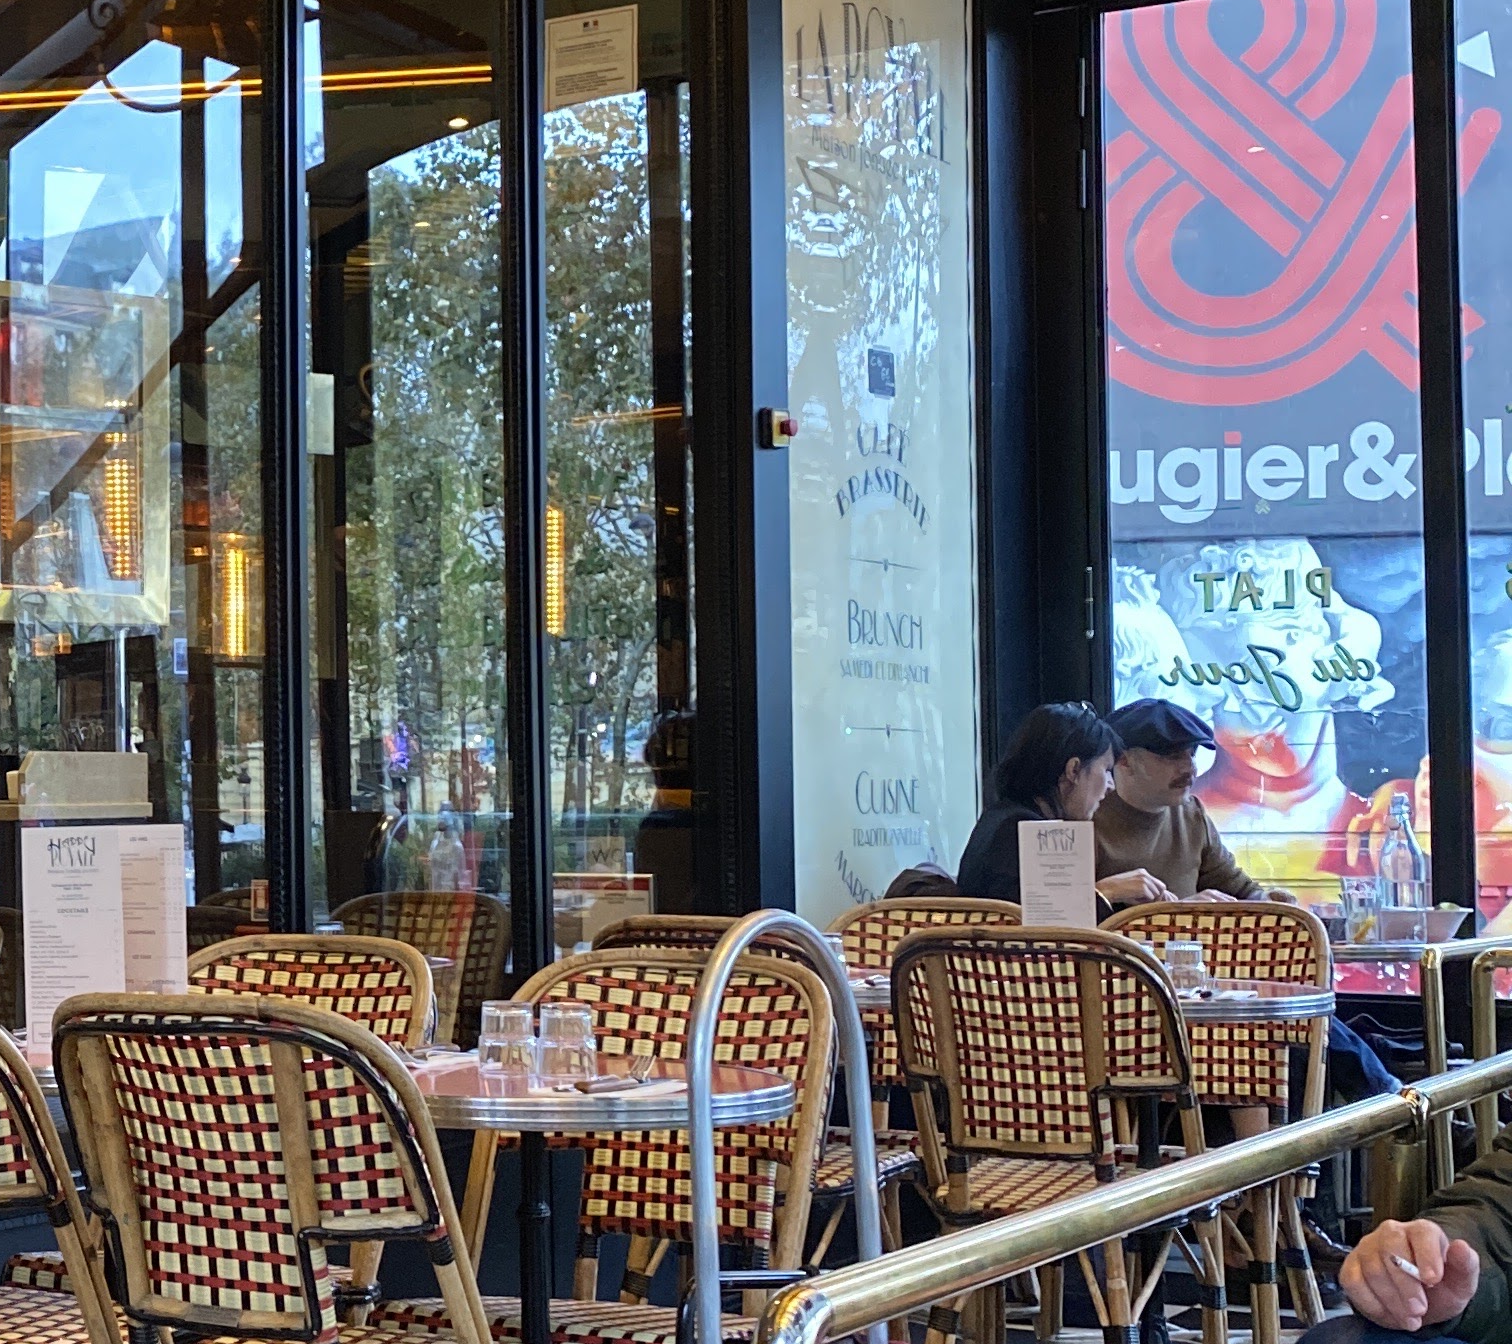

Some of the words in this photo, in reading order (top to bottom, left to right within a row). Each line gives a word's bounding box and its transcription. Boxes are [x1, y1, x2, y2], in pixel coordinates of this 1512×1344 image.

[835, 465, 931, 537] BRASSERIE
[847, 599, 923, 651] BRUNCH
[855, 770, 921, 815] CUISINE
